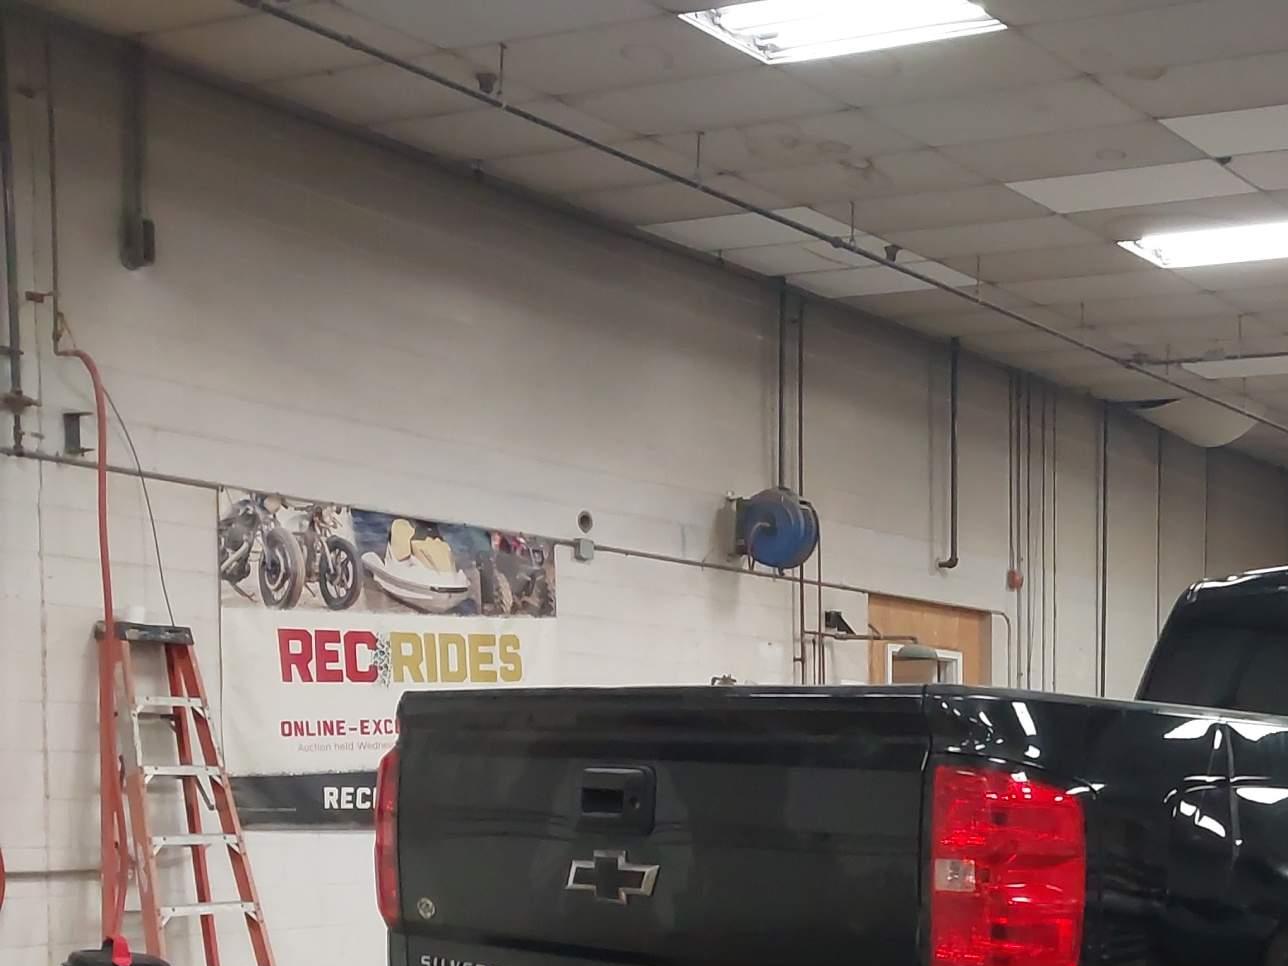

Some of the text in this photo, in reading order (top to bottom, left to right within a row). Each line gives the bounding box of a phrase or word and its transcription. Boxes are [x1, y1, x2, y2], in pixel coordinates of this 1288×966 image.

[277, 628, 523, 683] REC RIDES
[298, 742, 331, 752] Auction
[334, 741, 354, 751] held
